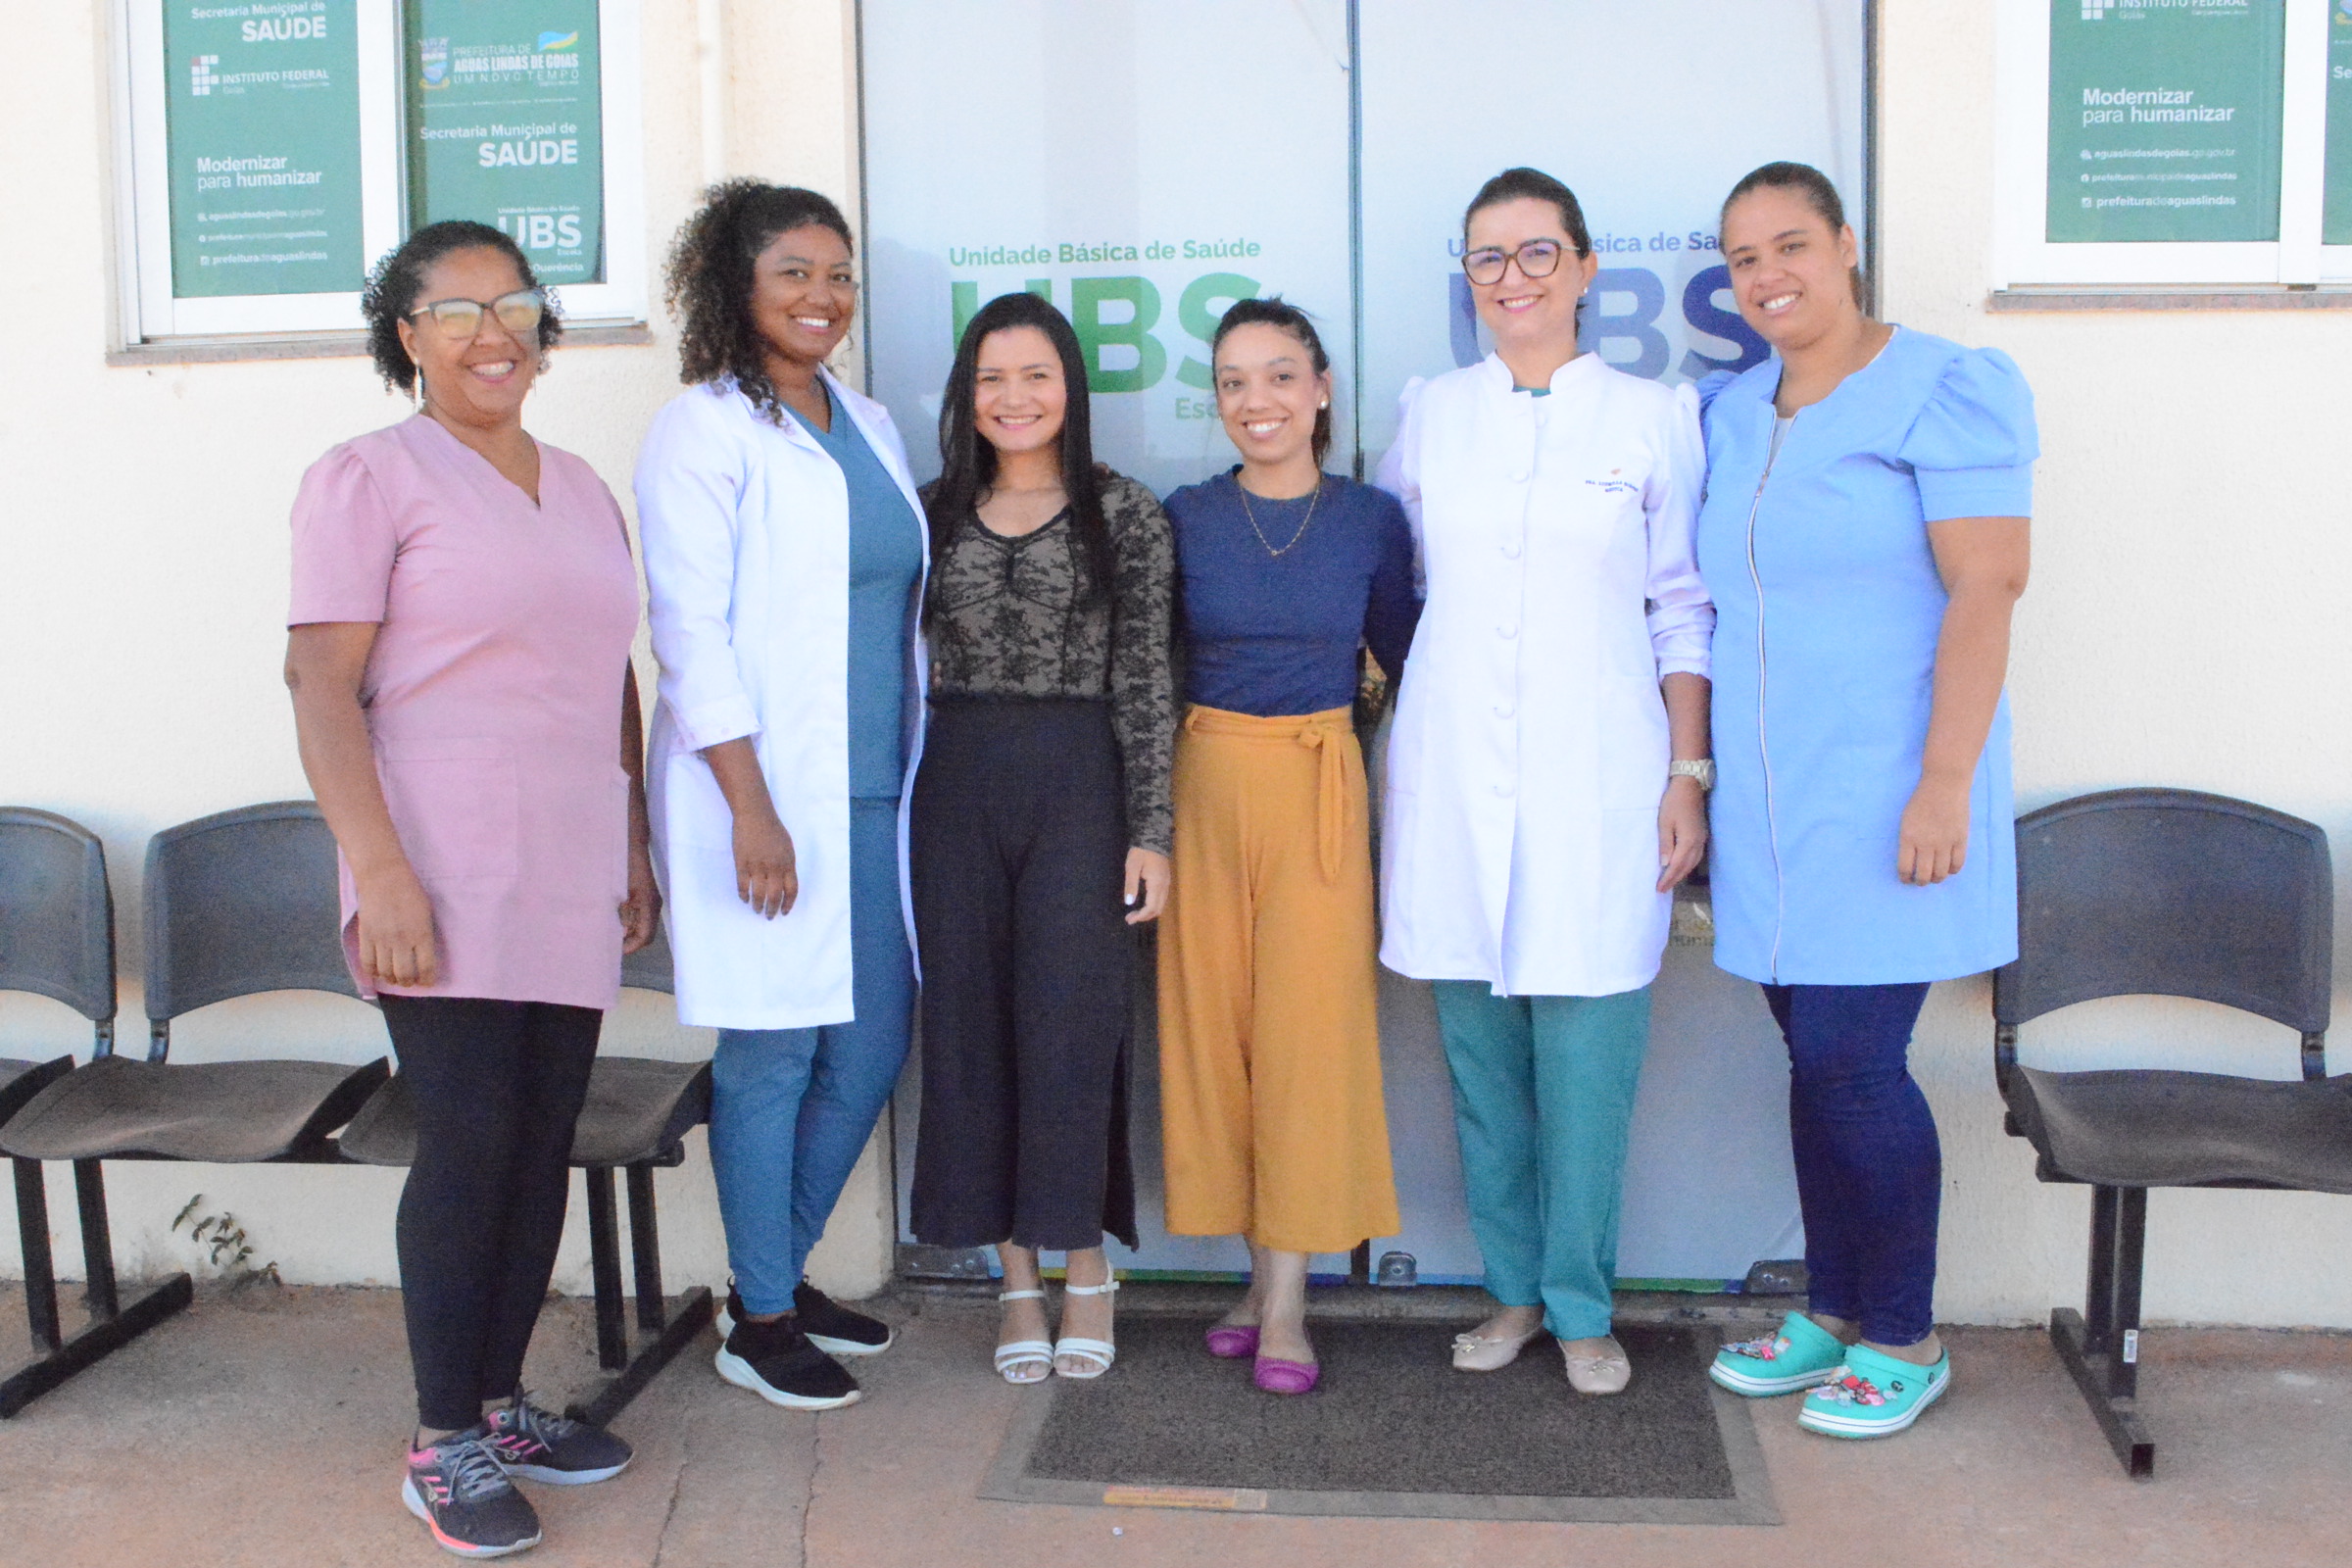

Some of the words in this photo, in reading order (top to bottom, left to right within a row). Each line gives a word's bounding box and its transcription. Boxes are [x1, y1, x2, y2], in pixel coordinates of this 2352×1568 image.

[191, 6, 249, 19] Secretaria
[252, 2, 308, 16] Municipal
[311, 1, 325, 12] de
[453, 45, 515, 57] PREFEITURA
[518, 43, 530, 54] DE
[491, 55, 528, 71] LINDAS
[531, 54, 544, 70] DE
[222, 72, 279, 83] INSTITUTO
[282, 69, 329, 80] FEDERAL
[454, 74, 474, 84] UM
[480, 72, 520, 83] NOVO
[527, 69, 579, 80] TEMPO
[2082, 87, 2193, 105] Modernizar
[2082, 110, 2124, 127] para
[2131, 105, 2234, 122] humanizar
[420, 125, 487, 139] Secretaria
[491, 122, 556, 137] Municipal
[560, 122, 577, 134] de
[478, 137, 578, 168] SAÚDE
[197, 155, 287, 172] Modernizar
[198, 174, 231, 192] para
[236, 170, 322, 187] humanizar
[498, 214, 582, 249] UBS
[1592, 232, 1642, 253] sica
[1648, 232, 1681, 252] de
[950, 244, 1052, 268] Unidade
[1058, 241, 1139, 264] Básica
[1145, 240, 1176, 261] de
[1183, 237, 1261, 260] Saúde
